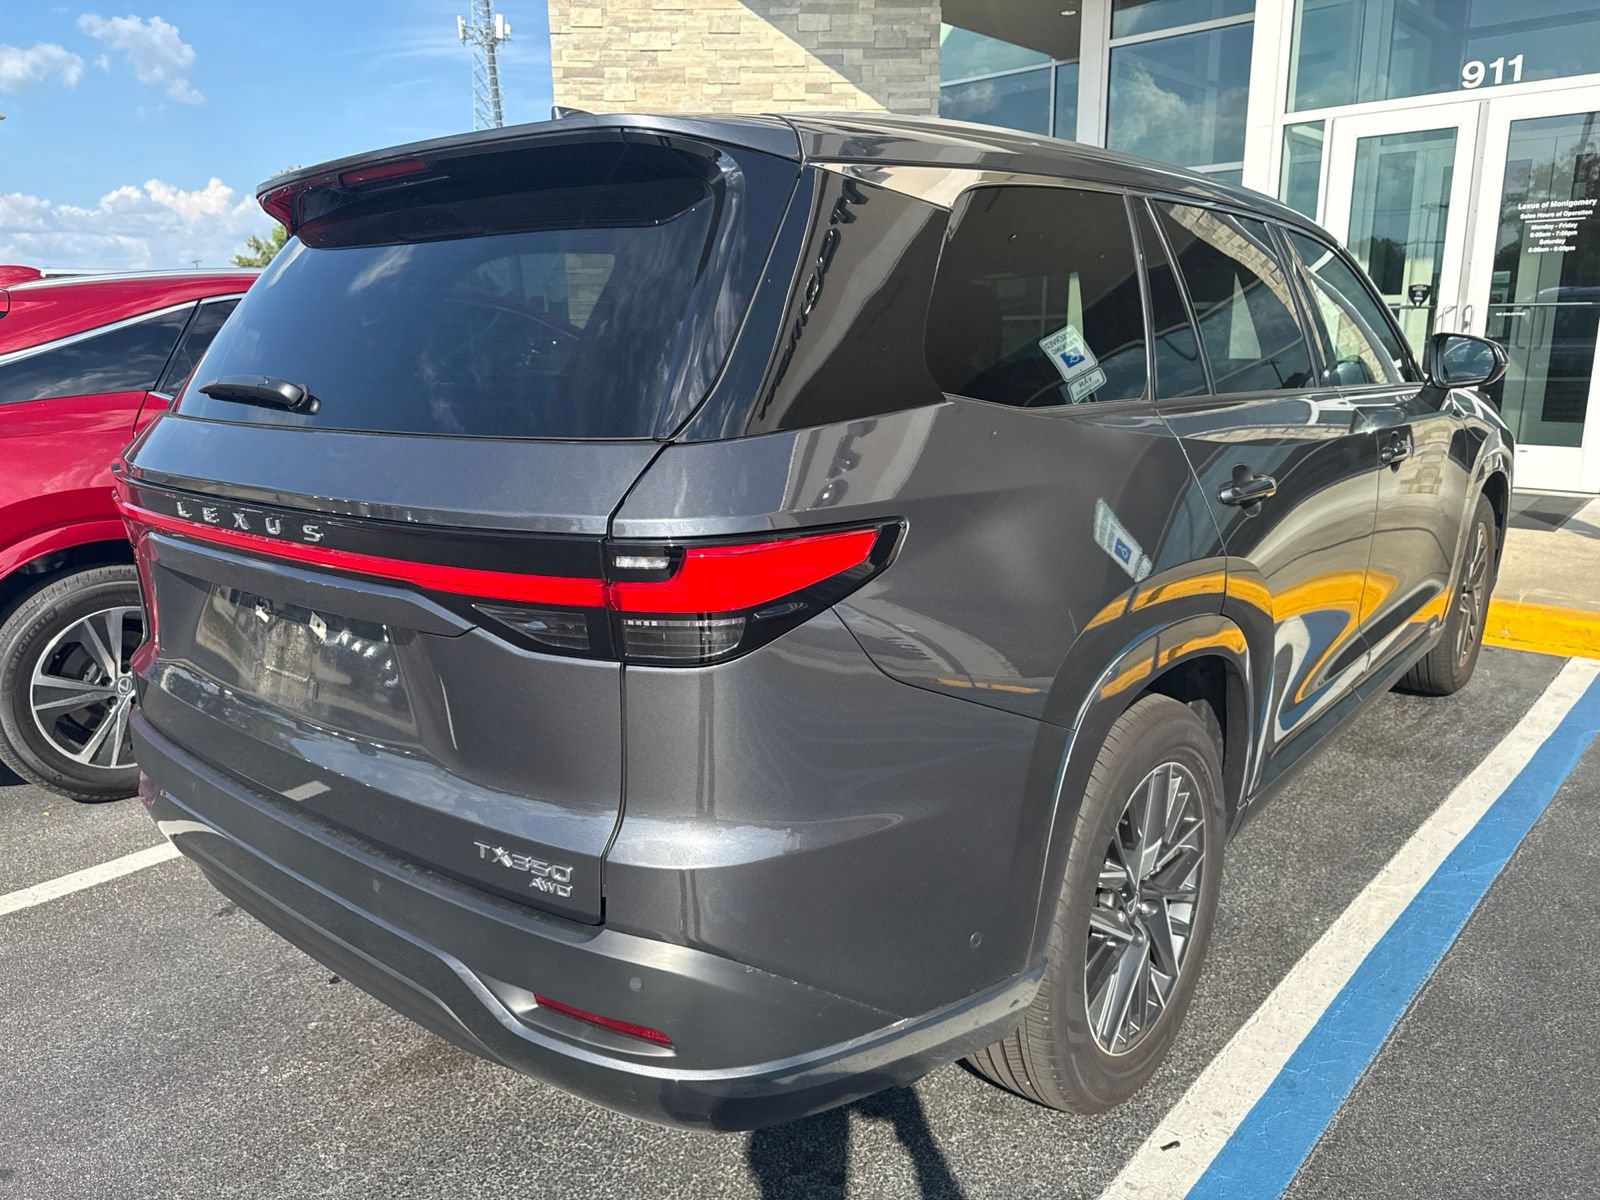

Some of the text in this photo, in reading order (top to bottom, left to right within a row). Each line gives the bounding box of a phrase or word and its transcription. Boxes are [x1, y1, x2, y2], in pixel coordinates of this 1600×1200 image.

[1461, 54, 1524, 89] 911
[1517, 203, 1540, 211] Lexus
[1550, 199, 1598, 207] Montgomery
[1563, 209, 1594, 217] Operation
[176, 501, 324, 543] LEXUS
[529, 877, 573, 898] AWD
